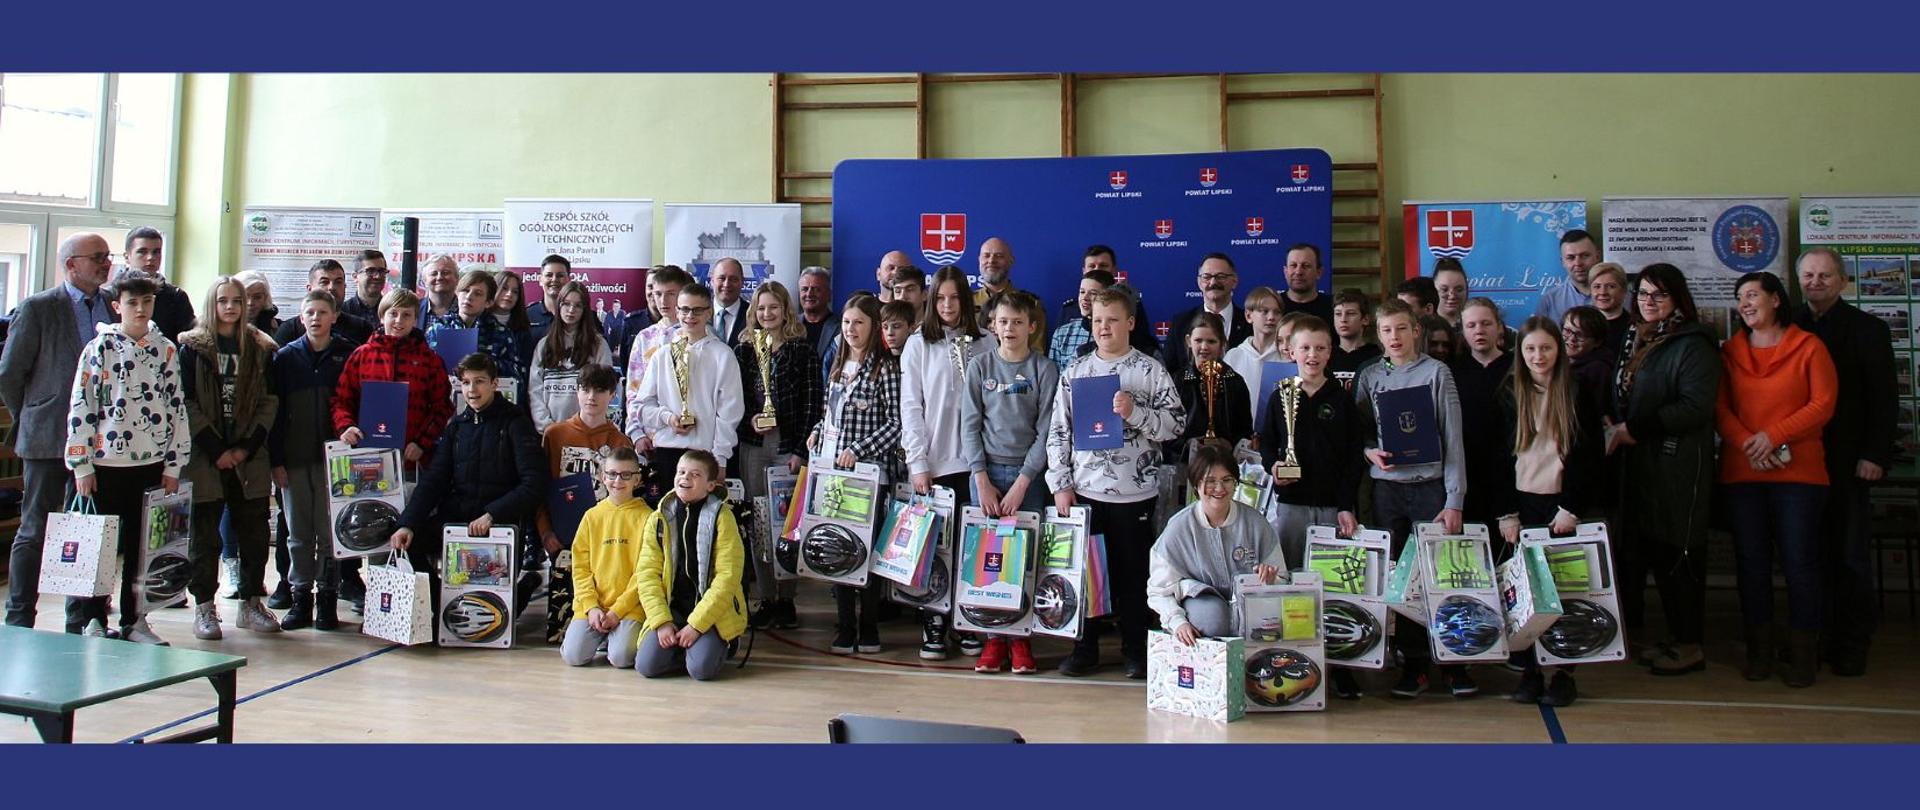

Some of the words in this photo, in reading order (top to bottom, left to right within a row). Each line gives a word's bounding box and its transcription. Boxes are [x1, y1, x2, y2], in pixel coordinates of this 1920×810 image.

[543, 209, 578, 221] ZESPÓŁ
[580, 209, 610, 221] SZKÓŁ
[519, 222, 634, 234] OGÓLNOKSZTAŁCĄCYCH
[543, 235, 615, 244] TECHNICZNYCH
